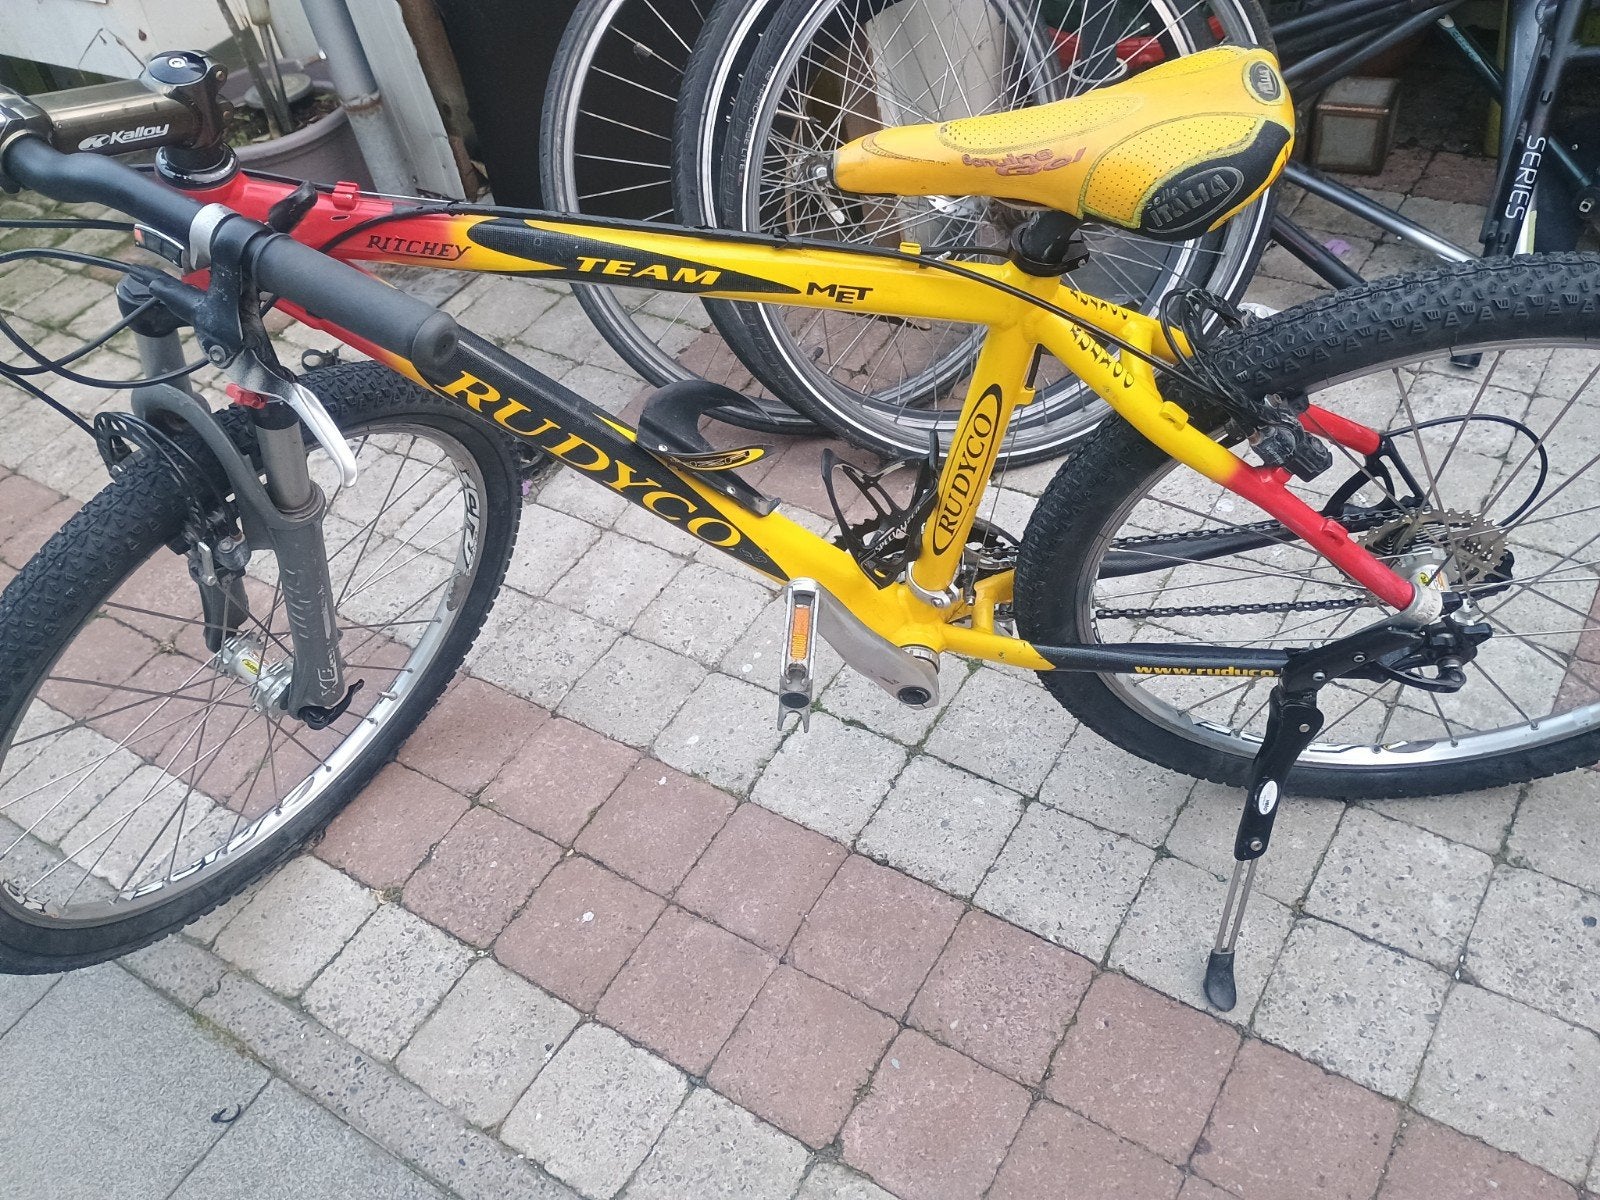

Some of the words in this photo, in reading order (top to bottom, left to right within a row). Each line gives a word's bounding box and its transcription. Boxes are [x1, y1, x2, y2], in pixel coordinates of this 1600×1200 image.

[109, 124, 170, 144] Kalloy
[1504, 134, 1547, 221] SERIES
[1150, 173, 1231, 228] ITALIA
[366, 234, 472, 261] RITCHEY
[576, 255, 722, 286] TEAM
[806, 281, 874, 304] MET
[434, 369, 742, 548] RUDYCO
[938, 412, 993, 537] RUDYCO
